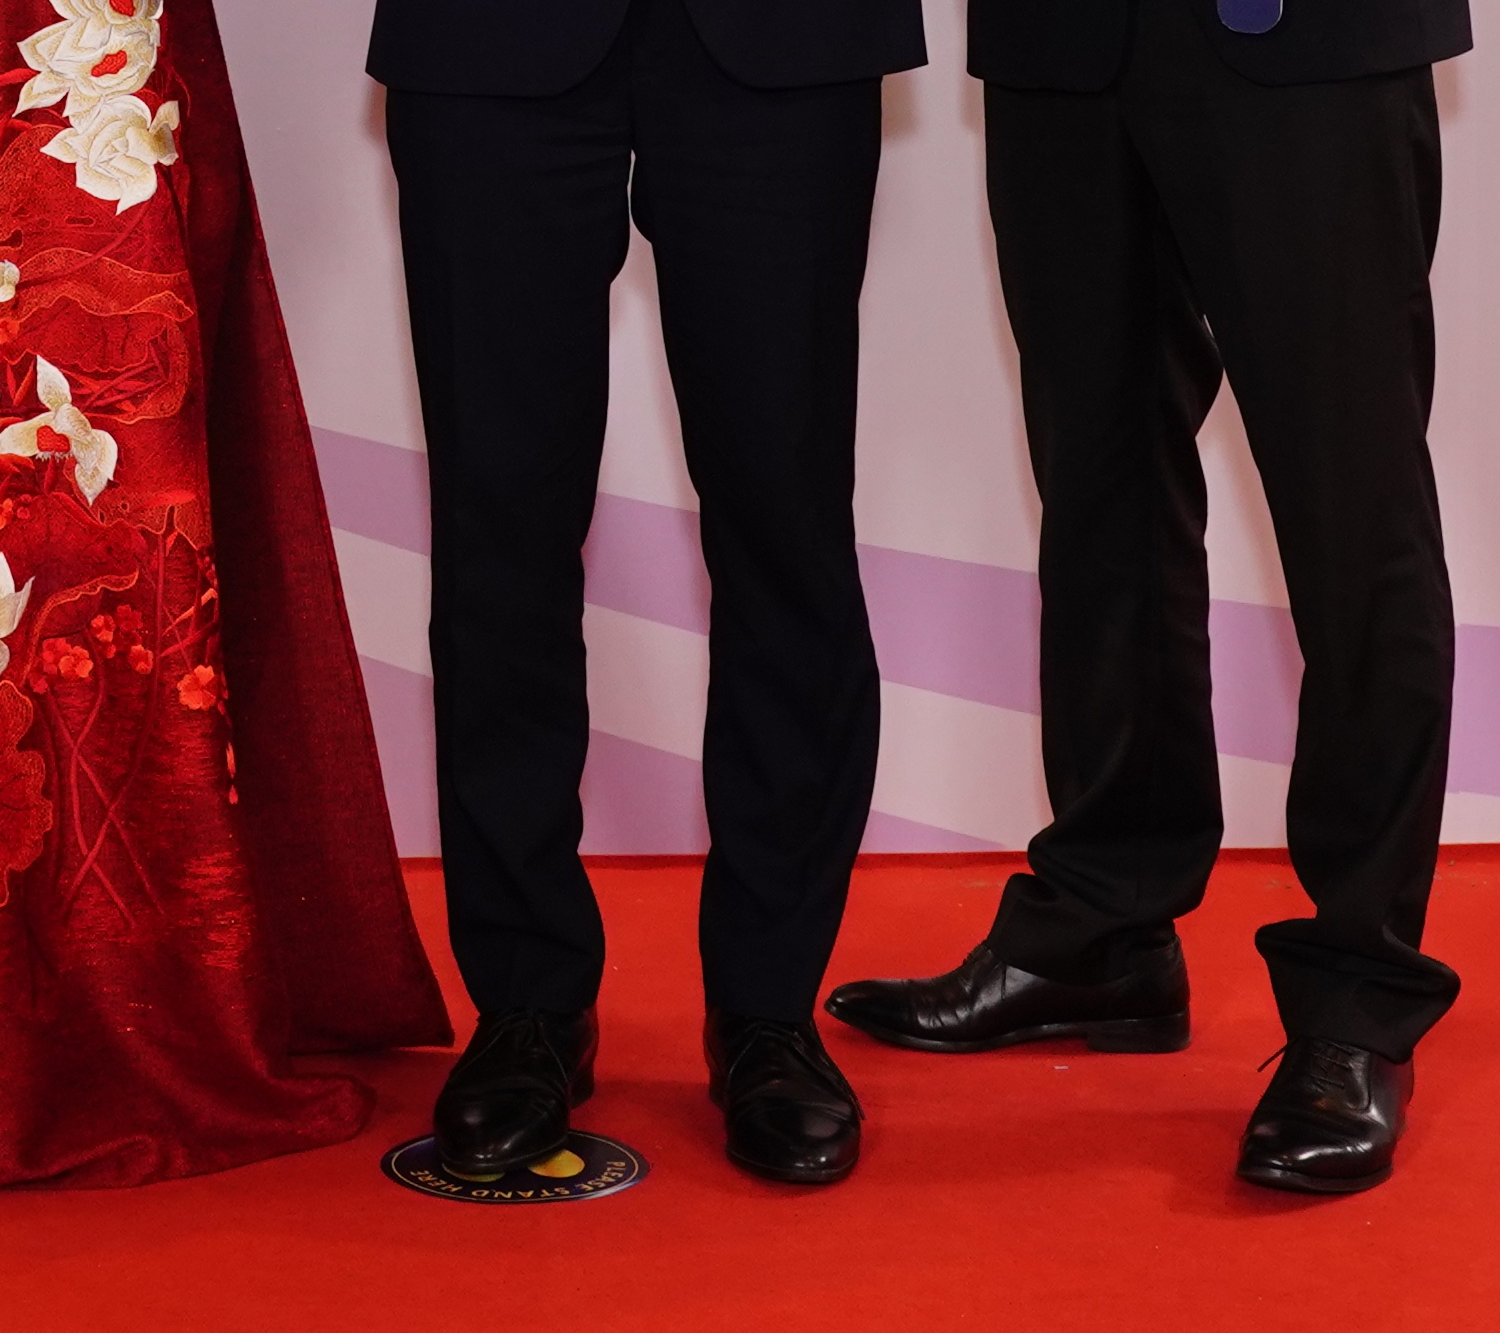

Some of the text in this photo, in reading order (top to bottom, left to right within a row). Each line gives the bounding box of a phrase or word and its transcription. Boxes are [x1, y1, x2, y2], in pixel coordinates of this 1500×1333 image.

[409, 1161, 627, 1199] PLEASE STAND HERE
